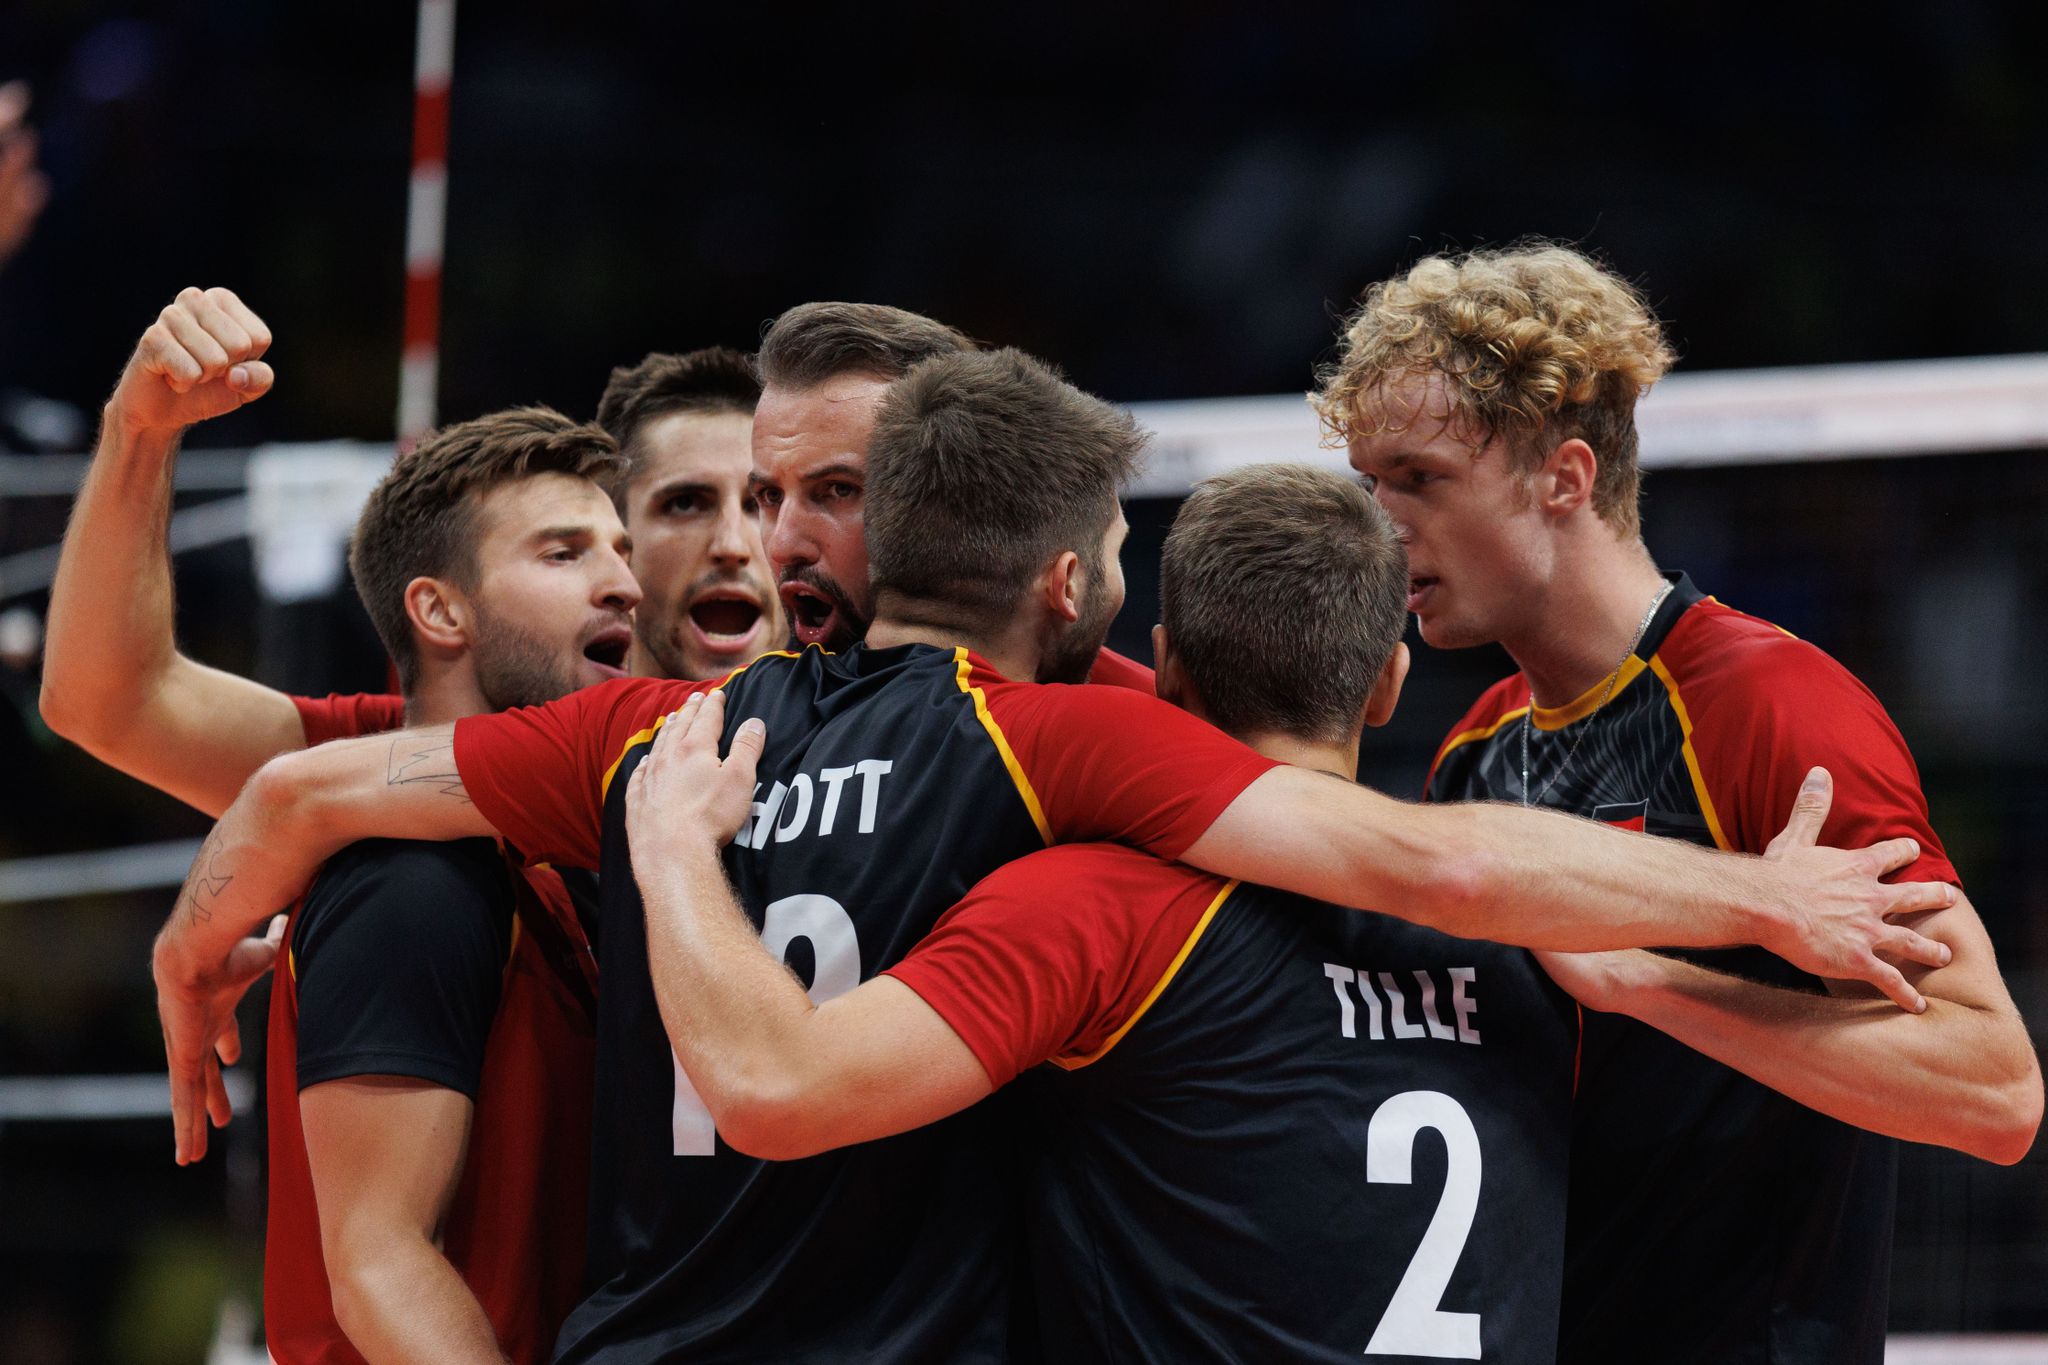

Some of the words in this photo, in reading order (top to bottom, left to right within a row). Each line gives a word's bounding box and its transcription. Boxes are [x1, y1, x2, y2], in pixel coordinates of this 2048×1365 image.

[734, 760, 893, 850] HOTT
[1324, 963, 1481, 1045] TILLE
[1364, 1090, 1482, 1360] 2
